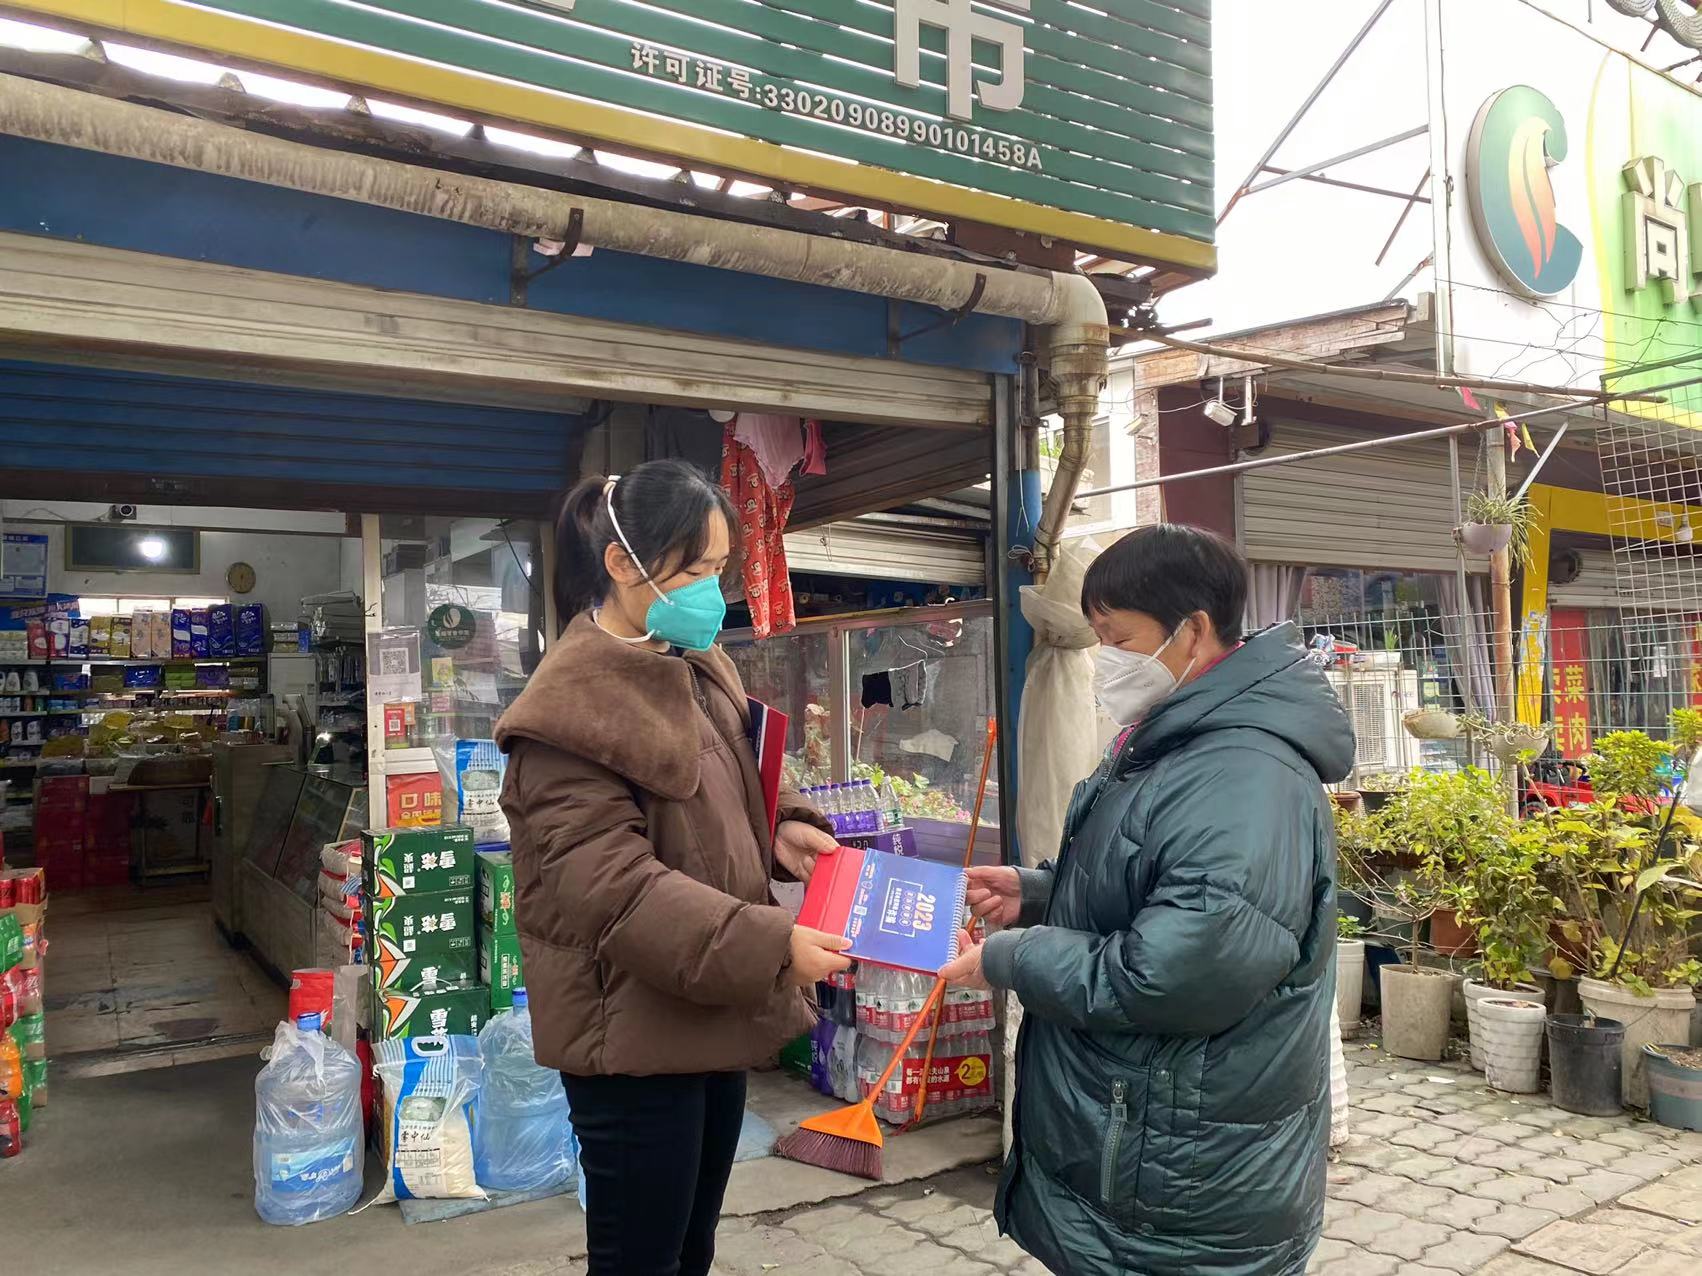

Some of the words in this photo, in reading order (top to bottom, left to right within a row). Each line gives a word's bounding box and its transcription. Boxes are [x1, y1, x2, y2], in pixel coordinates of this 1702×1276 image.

[630, 41, 1044, 170] 许可证号:33020908990101458A
[420, 850, 456, 870] 雪花
[421, 913, 456, 932] 雪花
[912, 893, 936, 931] 2023
